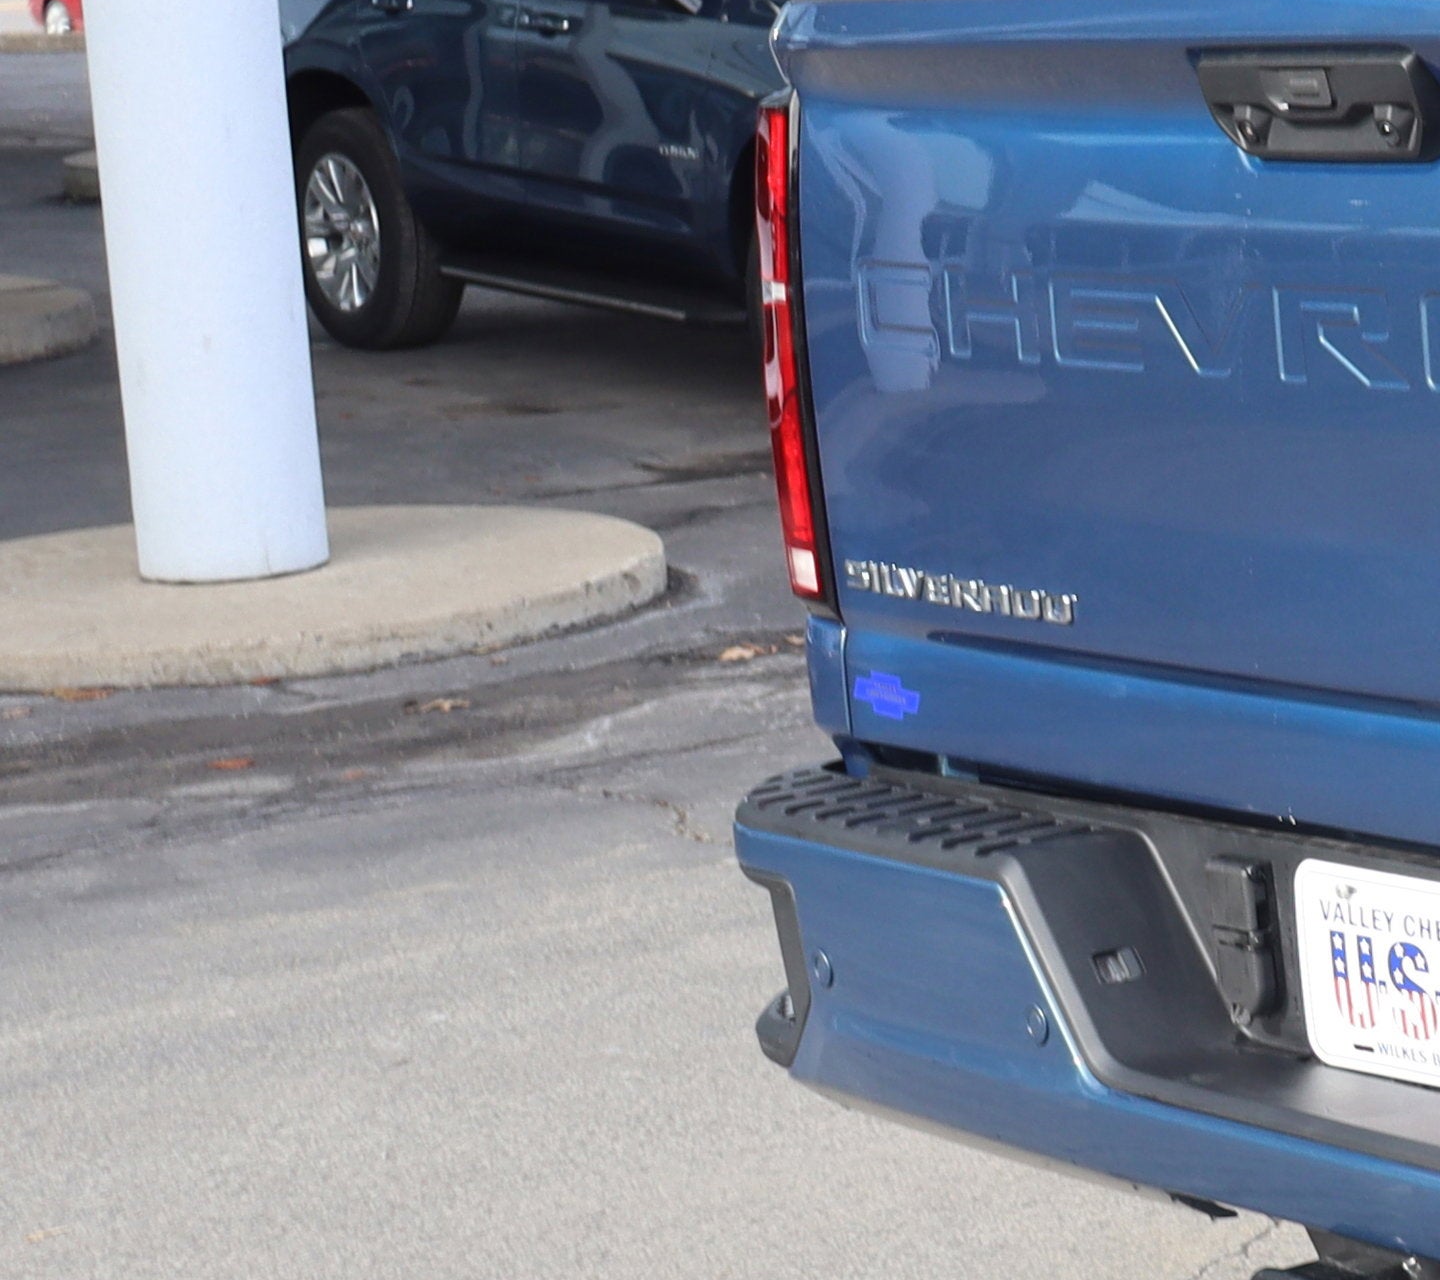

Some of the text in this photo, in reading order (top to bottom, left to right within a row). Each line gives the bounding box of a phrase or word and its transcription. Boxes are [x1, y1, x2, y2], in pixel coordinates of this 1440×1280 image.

[845, 558, 1078, 626] SILVERADO
[1319, 898, 1394, 933] VALLEY
[1377, 1041, 1428, 1064] WILKES
